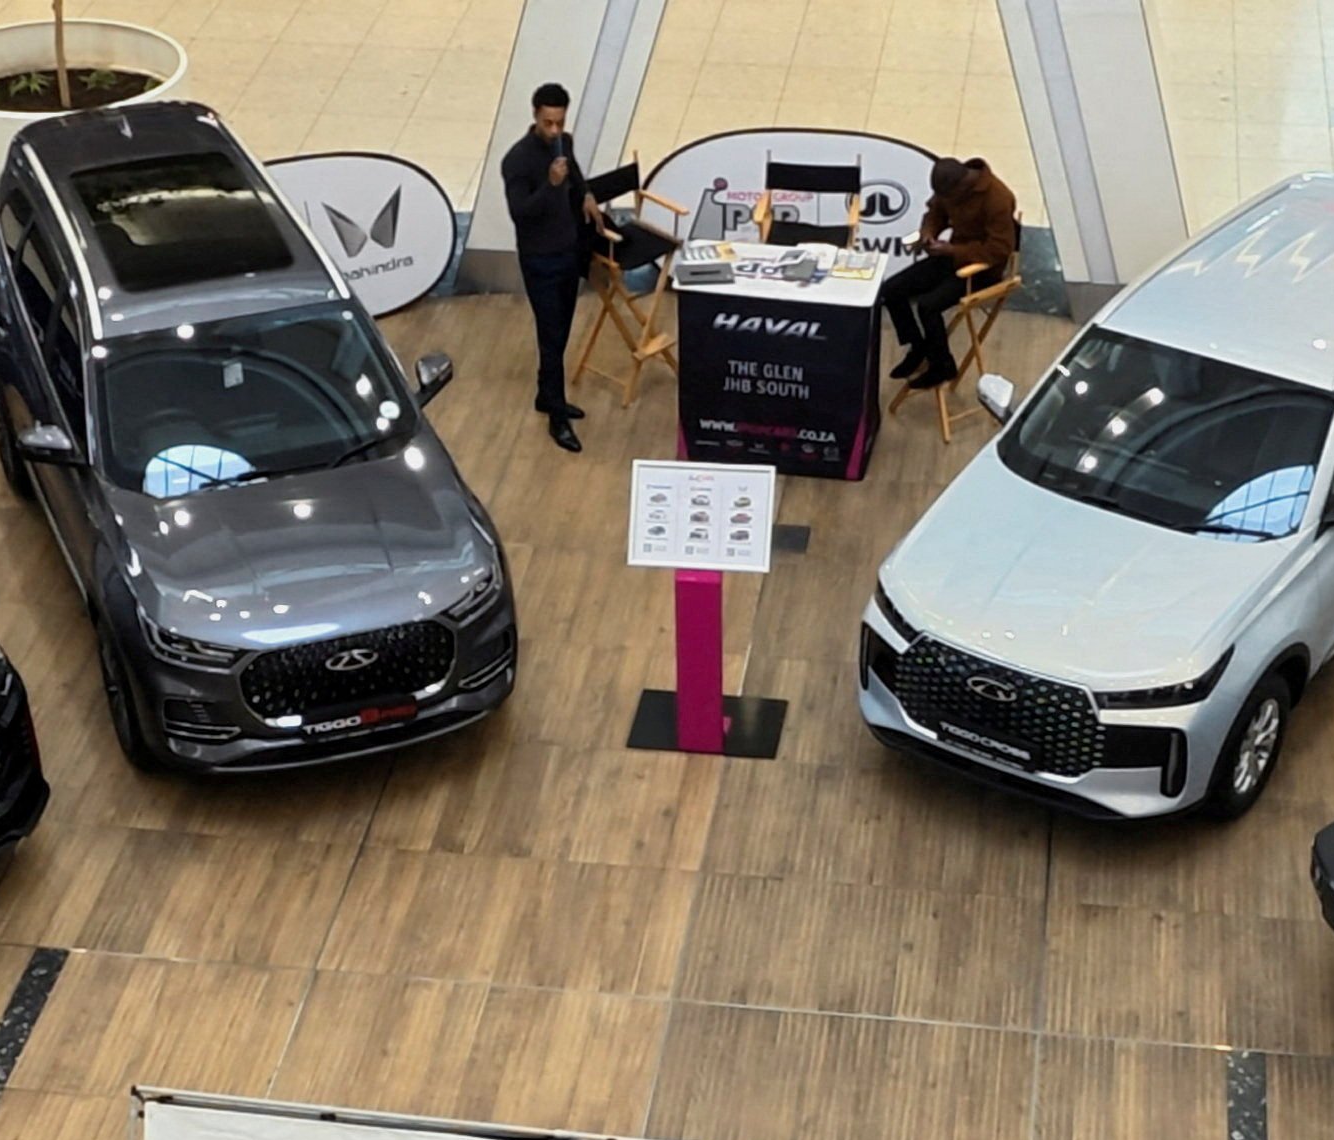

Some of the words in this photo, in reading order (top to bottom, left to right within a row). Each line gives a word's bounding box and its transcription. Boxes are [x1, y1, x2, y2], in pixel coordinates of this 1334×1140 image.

[726, 191, 763, 201] MOTO
[774, 192, 814, 202] GROUP
[854, 236, 923, 257] WM
[713, 313, 827, 340] HAVAL
[727, 360, 758, 377] THE
[763, 363, 804, 382] GLEN
[723, 376, 752, 394] JHB
[756, 380, 810, 400] SOUTH
[303, 715, 362, 735] TIGGO
